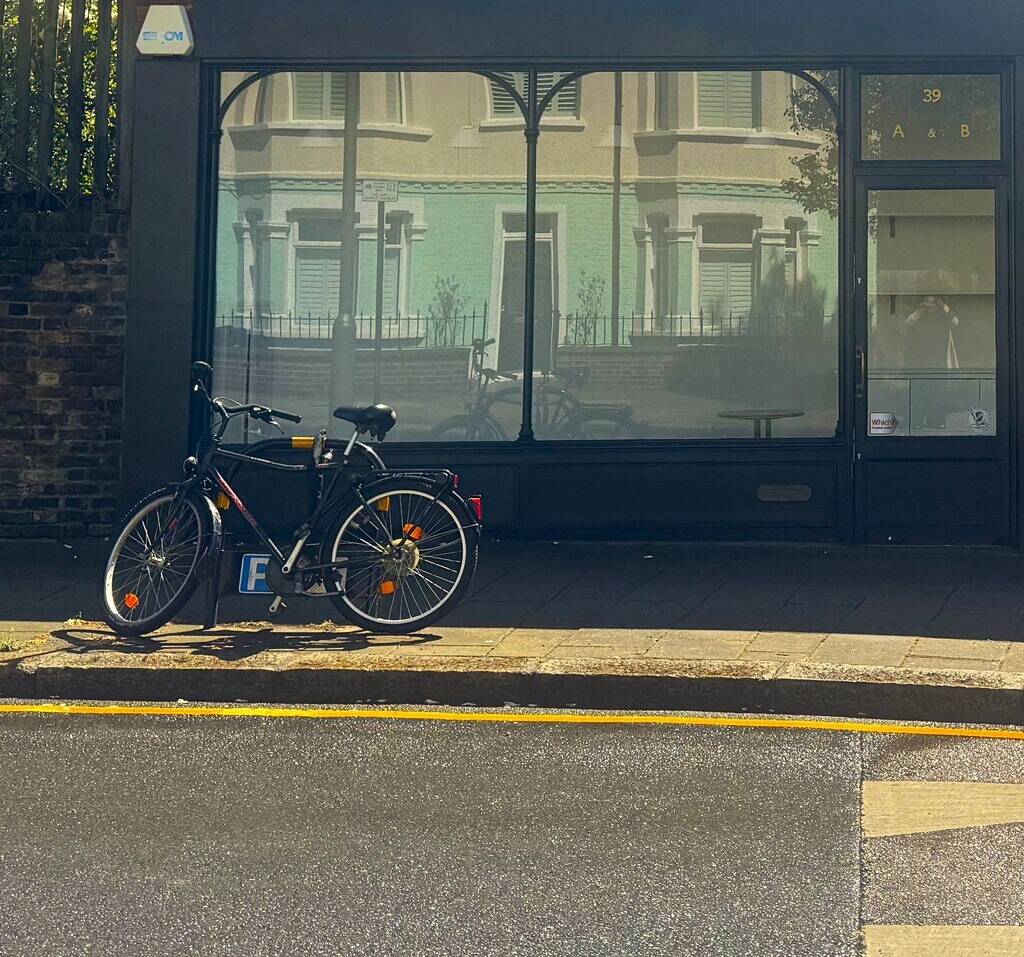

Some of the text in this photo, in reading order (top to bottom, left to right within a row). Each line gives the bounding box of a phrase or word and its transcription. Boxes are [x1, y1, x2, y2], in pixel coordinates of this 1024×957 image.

[923, 89, 942, 103] 39
[893, 124, 970, 138] A & B
[871, 418, 896, 426] Which?
